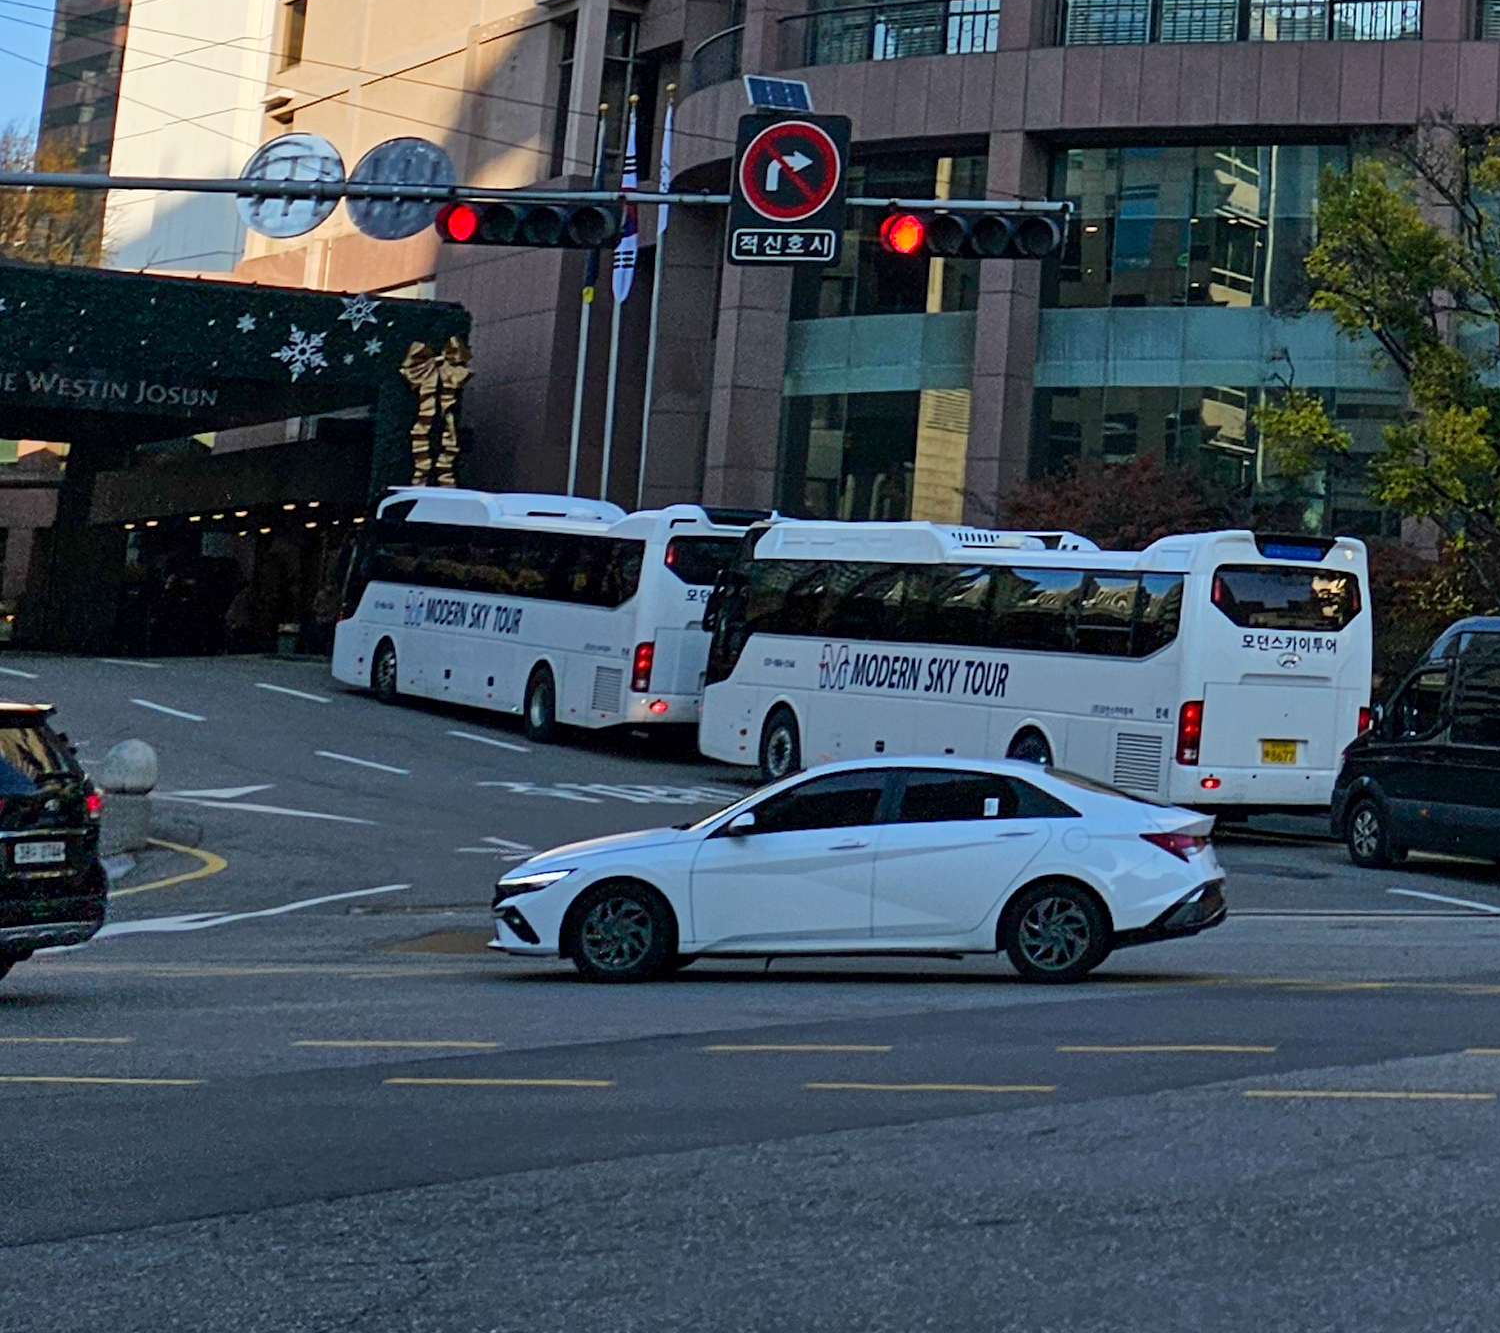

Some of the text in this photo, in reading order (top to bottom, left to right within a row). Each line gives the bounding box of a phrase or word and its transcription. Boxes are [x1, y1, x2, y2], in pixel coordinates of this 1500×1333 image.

[134, 380, 218, 407] JOSUN
[424, 598, 523, 634] MODERN SKY TOUR
[1242, 635, 1337, 654] 모던스카이투어
[850, 653, 923, 691] MODERN
[924, 657, 961, 694] SKY
[963, 660, 1009, 697] TOUR
